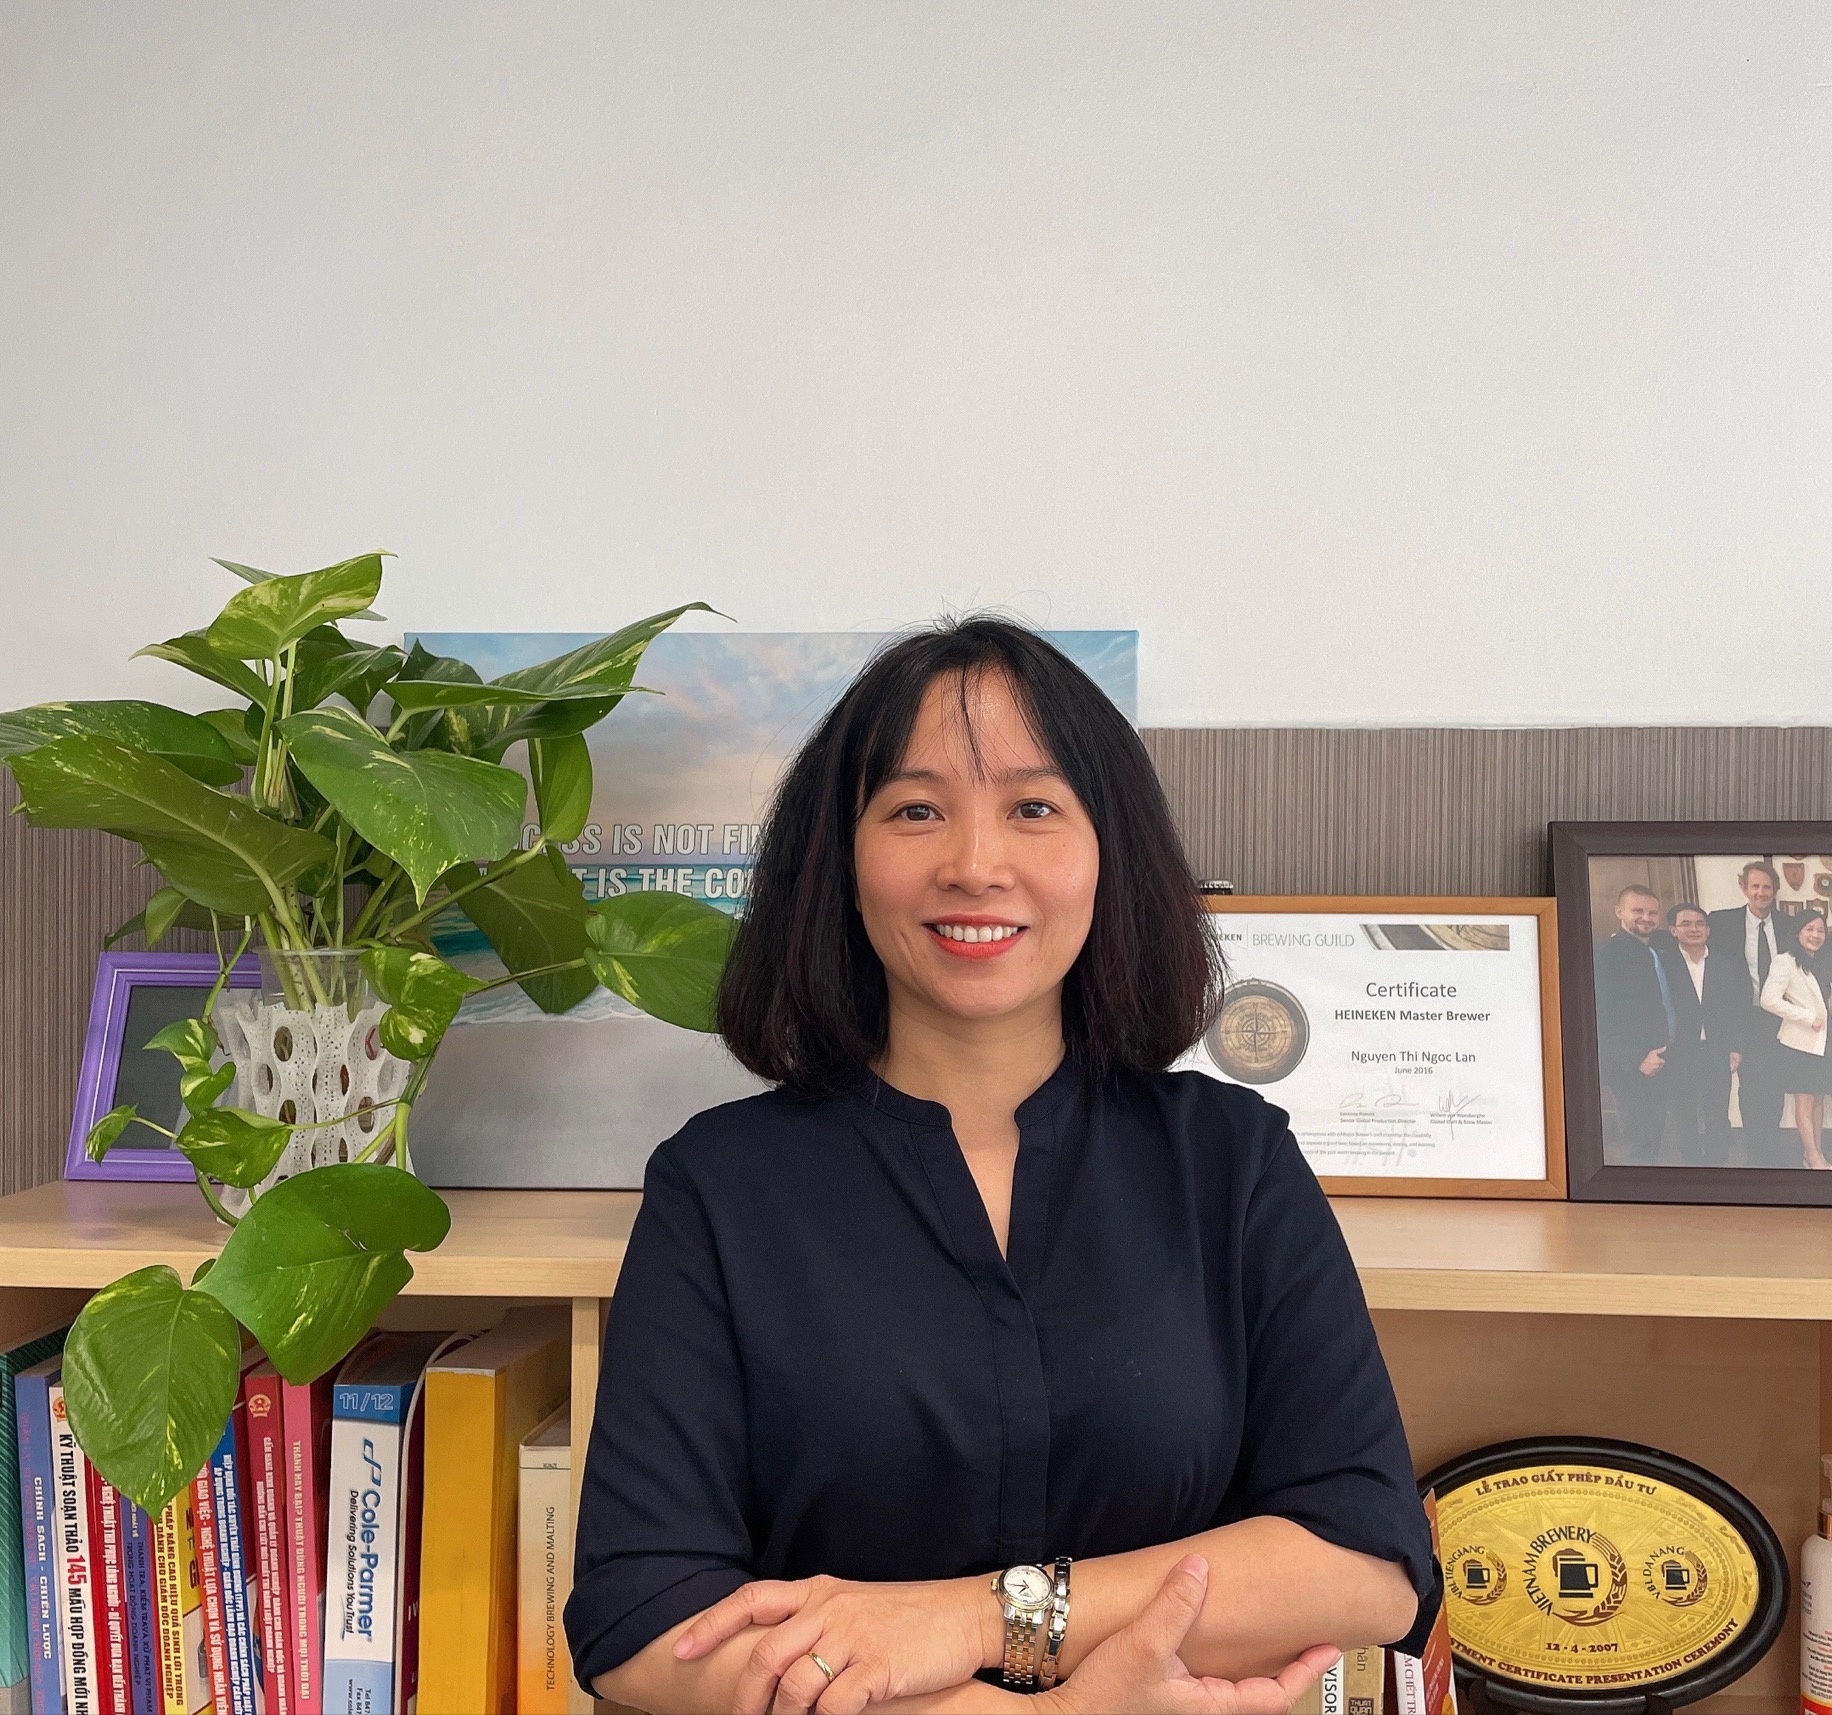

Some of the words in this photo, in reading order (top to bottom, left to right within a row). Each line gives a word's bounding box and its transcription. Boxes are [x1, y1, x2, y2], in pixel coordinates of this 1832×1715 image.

[612, 824, 644, 855] IS
[652, 824, 714, 855] NOT
[597, 868, 628, 898] IS
[640, 867, 694, 896] THE
[1252, 934, 1311, 946] BREWING
[1314, 934, 1354, 947] GUILD
[1366, 982, 1457, 998] Certificate
[1334, 1010, 1396, 1020] HEINEKEN
[1400, 1011, 1443, 1021] Master
[1446, 1011, 1490, 1021] Brewer
[1351, 1051, 1396, 1064] Nguyen
[1400, 1051, 1418, 1061] Thi
[1422, 1052, 1452, 1064] Ngoc
[1455, 1052, 1476, 1062] Lan
[340, 1392, 394, 1412] 11/12
[60, 1434, 77, 1448] KỸ
[59, 1452, 77, 1487] THUẬT
[197, 1480, 209, 1500] GIAO
[1475, 1481, 1492, 1496] LỄ
[1494, 1476, 1528, 1490] TRAO
[1531, 1470, 1564, 1483] GIẤY
[1638, 1483, 1657, 1495] TƯ
[61, 1490, 77, 1520] SOẠN
[196, 1501, 212, 1520] VIỆC
[345, 1490, 359, 1542] Delivering
[65, 1523, 82, 1552] THẢO
[200, 1527, 214, 1550] NGHỆ
[1530, 1526, 1596, 1554] BREWERY
[67, 1555, 87, 1585] 145
[168, 1562, 176, 1581] CAO
[201, 1551, 217, 1576] THUẬT
[347, 1545, 357, 1590] Solutions
[1448, 1580, 1462, 1599] VBL
[1522, 1552, 1554, 1616] VIETNAM
[1645, 1578, 1660, 1599] VBL
[69, 1588, 86, 1613] MẪU
[346, 1593, 355, 1610] You
[547, 1577, 555, 1621] BREWING
[68, 1617, 84, 1639] HỢP
[346, 1612, 354, 1633] Trust
[72, 1643, 89, 1674] ĐỒNG
[546, 1624, 555, 1690] TECHNOLOGY
[1498, 1661, 1583, 1684] CERTIFICATE
[1586, 1659, 1682, 1684] PRESENTATION
[1683, 1618, 1739, 1663] CEREMONY
[1570, 1645, 1578, 1653] 4
[1589, 1643, 1618, 1652] 2007
[74, 1677, 90, 1698] MỚI
[1405, 1669, 1417, 1698] CHẾT
